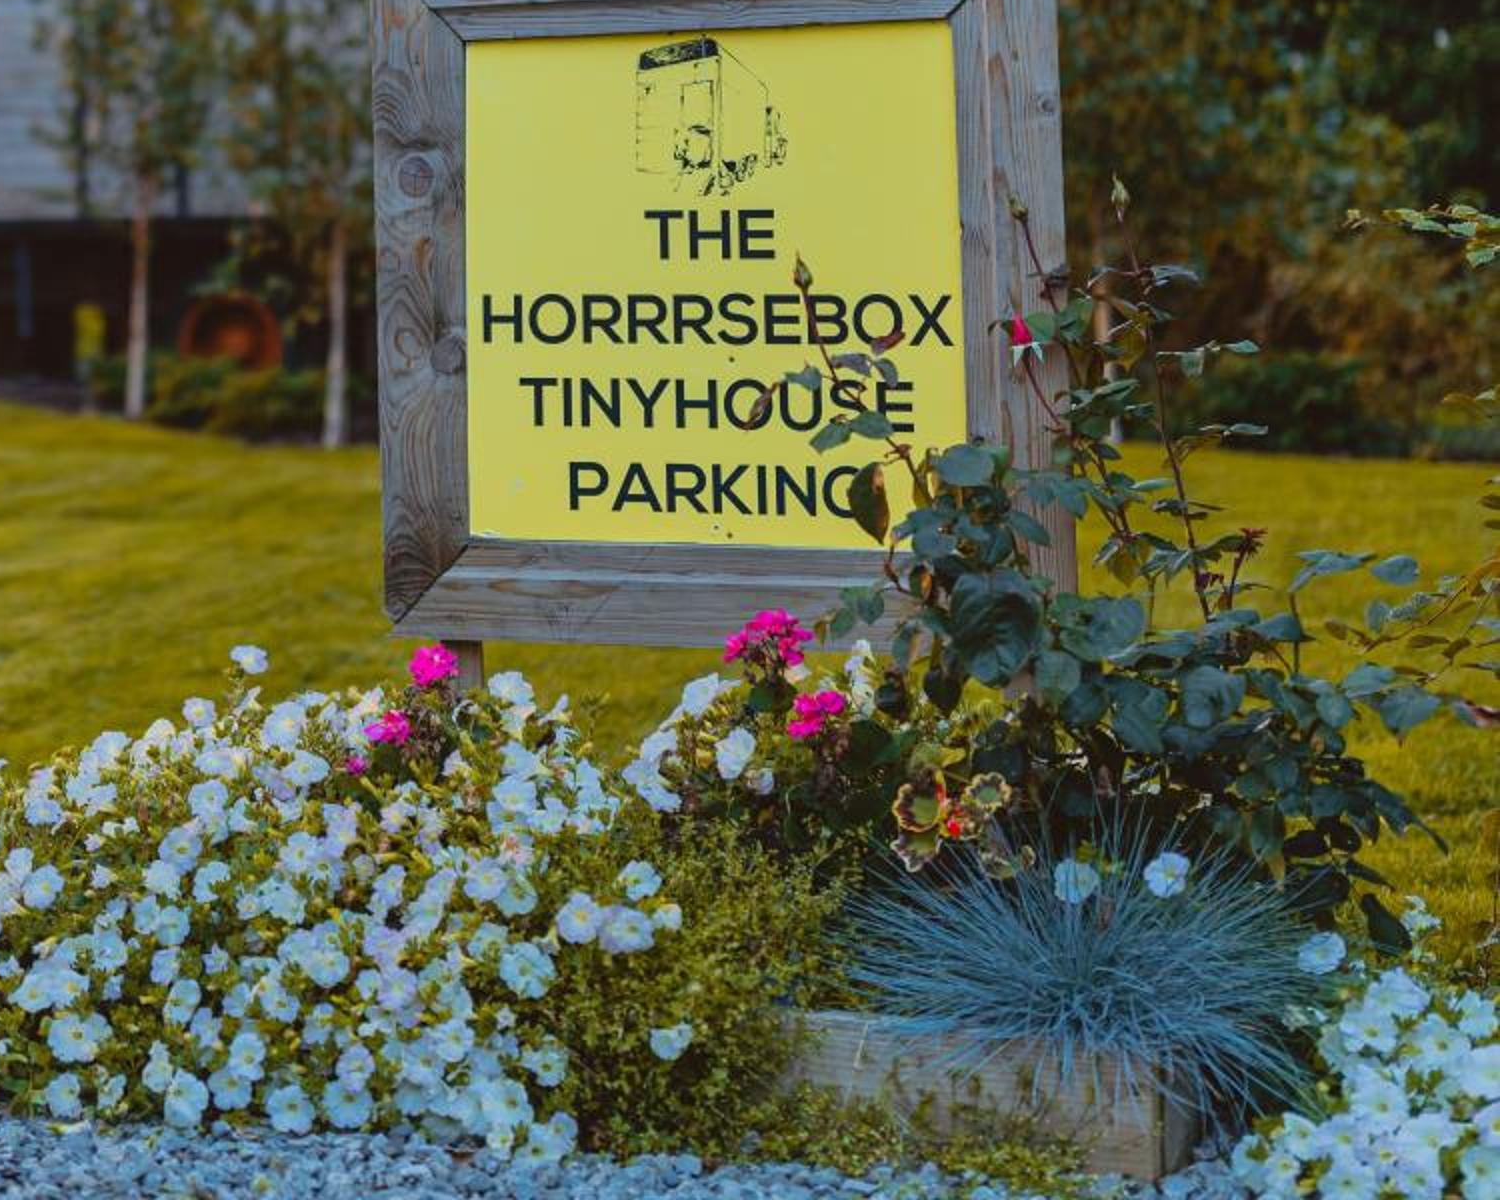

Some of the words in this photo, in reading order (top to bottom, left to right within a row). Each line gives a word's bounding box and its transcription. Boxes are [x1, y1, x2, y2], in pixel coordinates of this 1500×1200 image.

[644, 209, 776, 260] THE
[481, 293, 954, 346] HORRRSEBOX
[519, 377, 915, 433] TINYHOUSE
